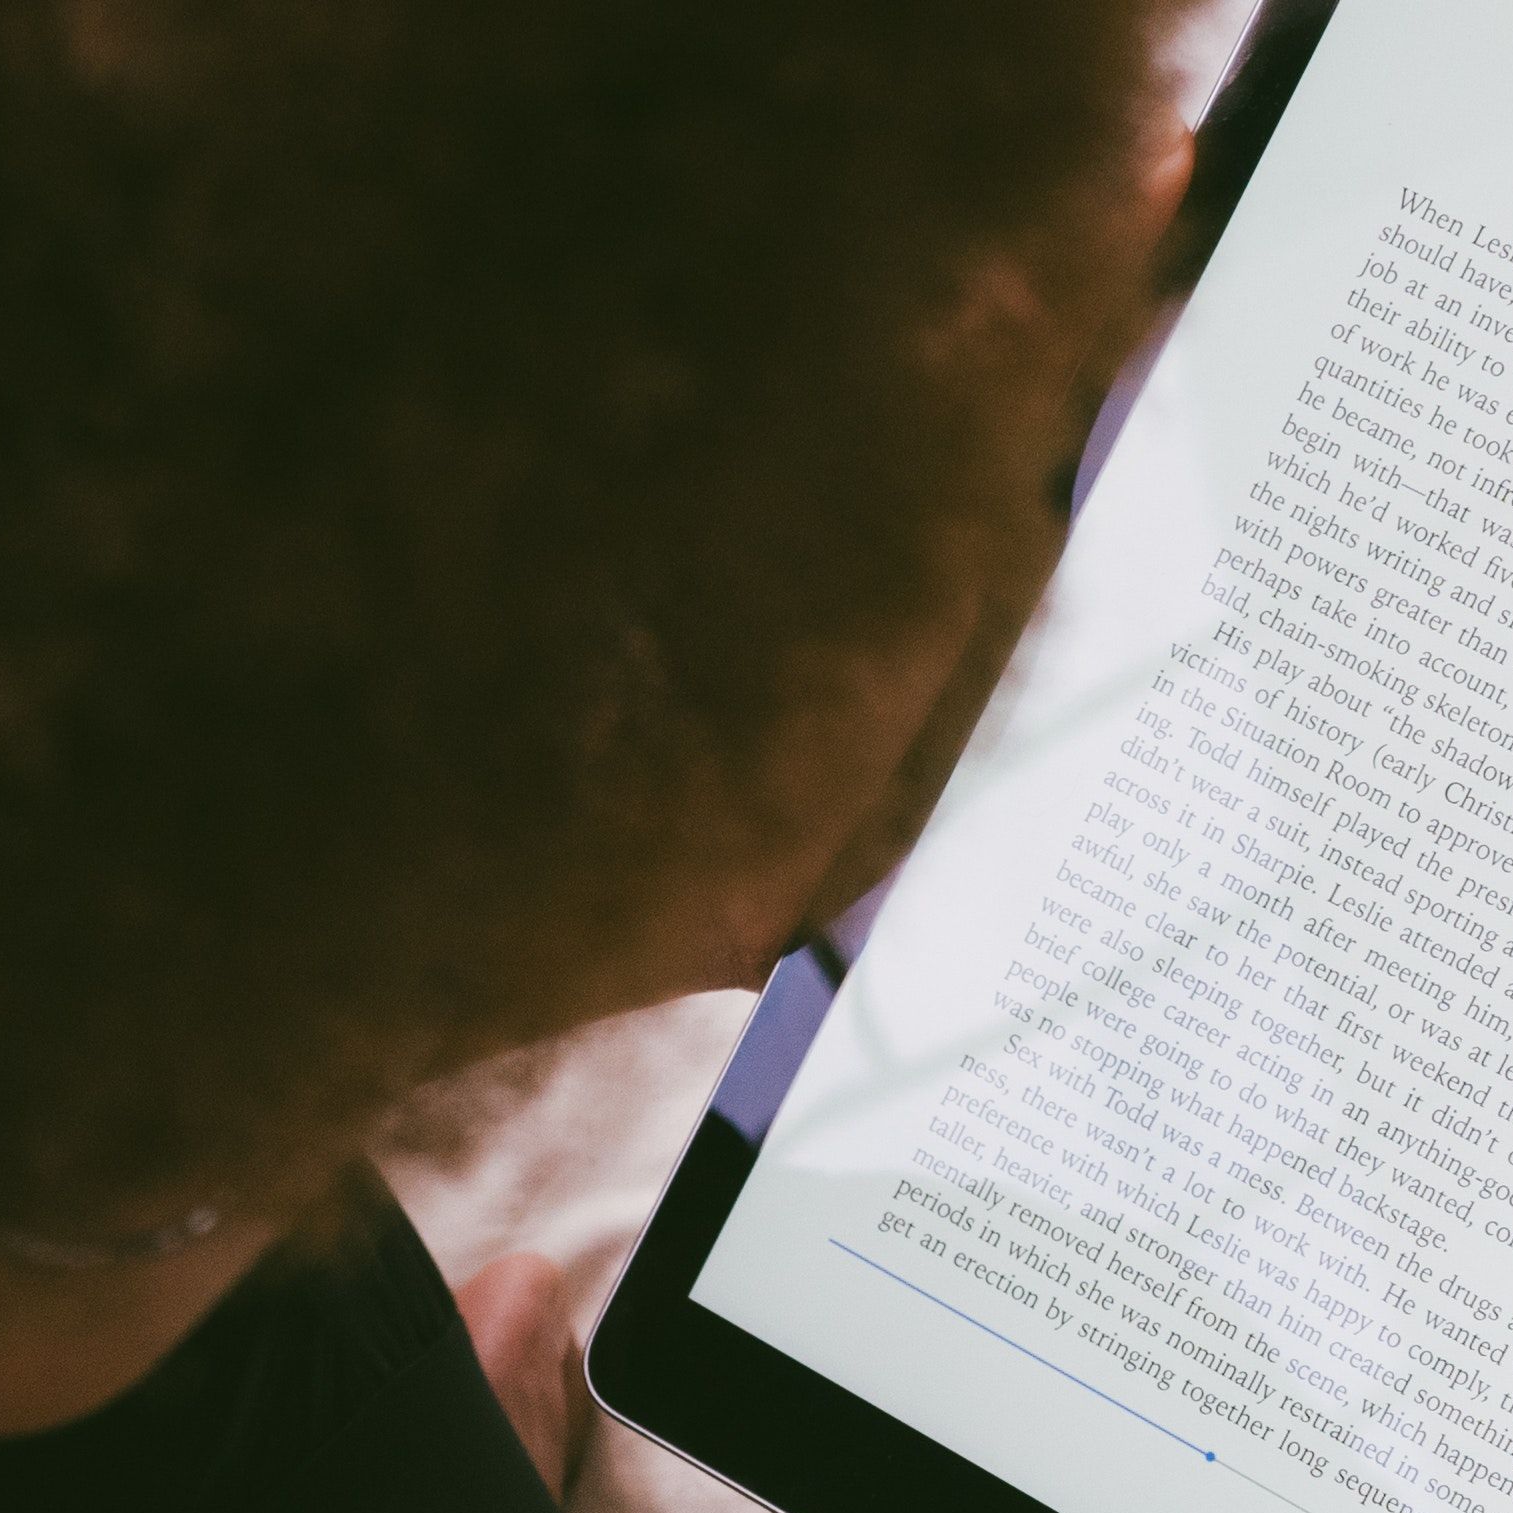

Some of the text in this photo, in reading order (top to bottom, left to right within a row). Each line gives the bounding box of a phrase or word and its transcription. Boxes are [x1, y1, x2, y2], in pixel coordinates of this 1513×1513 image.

[1399, 186, 1464, 238] When
[1346, 287, 1402, 327] their
[1404, 317, 1478, 367] ability
[1480, 354, 1506, 378] to
[1296, 379, 1326, 411] he
[1331, 396, 1417, 461] became,
[1425, 451, 1468, 481] not
[1234, 514, 1284, 552] with
[1283, 543, 1369, 594] powers
[1369, 587, 1454, 636] greater
[1457, 626, 1509, 666] than
[1249, 480, 1286, 512] the
[1288, 503, 1361, 549] nights
[1366, 540, 1447, 598] writing
[1449, 585, 1497, 617] and
[1200, 572, 1252, 620] bald,
[1258, 607, 1421, 707] chain-smoking
[1211, 619, 1253, 656] His
[1251, 648, 1306, 686] play
[1306, 673, 1373, 718] about
[1382, 705, 1427, 745] “the
[1170, 642, 1248, 694] victims
[1254, 688, 1285, 710] of
[1283, 695, 1365, 757] history
[1372, 743, 1438, 795] (early
[1120, 735, 1186, 783] didn’t
[1191, 774, 1244, 812] wear
[1246, 806, 1261, 823] a
[1264, 815, 1311, 854] suit,
[1318, 837, 1405, 897] instead
[1403, 888, 1501, 953] sporting
[1023, 921, 1081, 965] brief
[1081, 960, 1156, 1009] college
[1163, 1004, 1231, 1049] career
[1235, 1044, 1304, 1095] acting
[1309, 1078, 1335, 1107] in
[1341, 1101, 1370, 1127] an
[876, 1210, 917, 1240] get
[919, 1232, 948, 1259] an
[952, 1251, 1040, 1311] erection
[1044, 1296, 1075, 1332] by
[1076, 1322, 1177, 1392] stringing
[1180, 1378, 1275, 1442] together
[1277, 1428, 1331, 1479] long
[911, 1148, 1006, 1212] mentally
[1007, 1201, 1106, 1265] removed
[1105, 1249, 1189, 1309] herself
[1183, 1295, 1238, 1342] from
[1244, 1331, 1281, 1364] the
[1284, 1358, 1349, 1408] scene,
[1361, 1397, 1427, 1448] which
